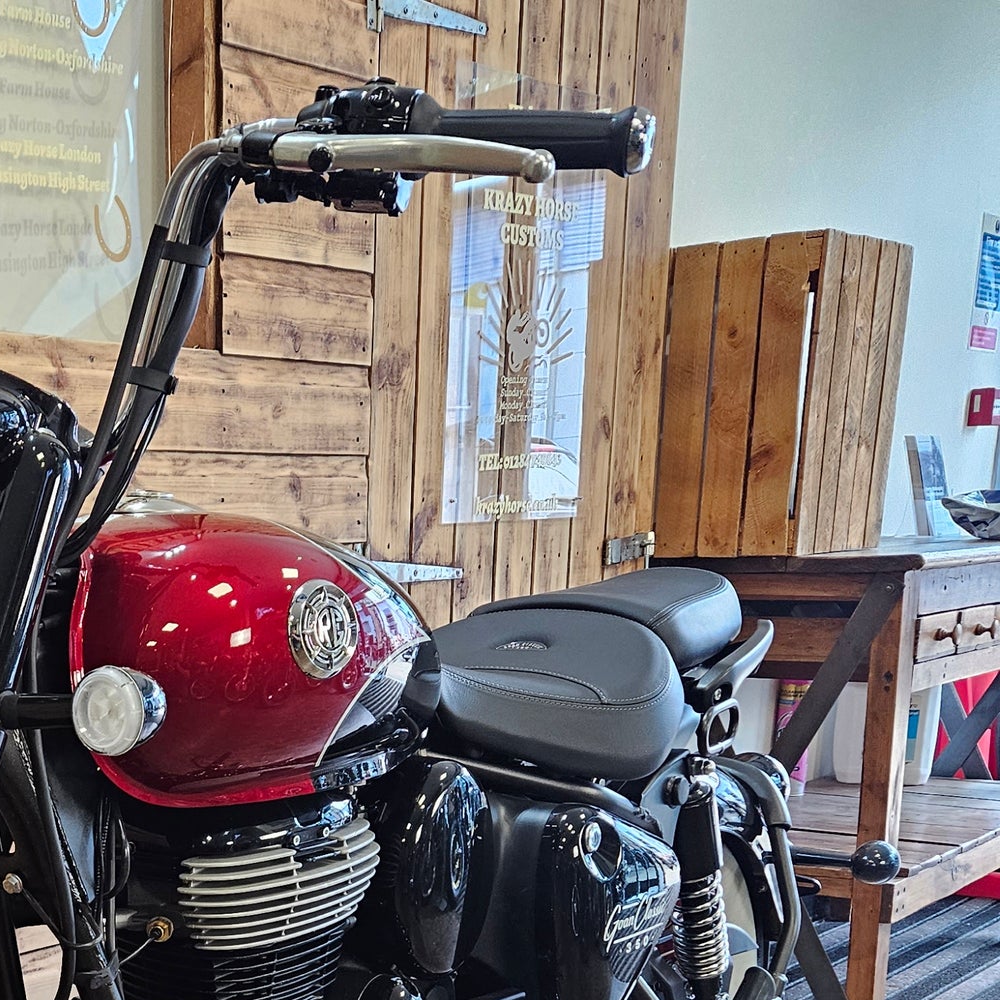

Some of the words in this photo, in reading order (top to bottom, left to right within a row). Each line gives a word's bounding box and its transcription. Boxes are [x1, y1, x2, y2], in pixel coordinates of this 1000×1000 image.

[34, 7, 72, 29] House
[22, 139, 58, 160] Horse
[59, 143, 102, 165] London
[48, 170, 77, 194] High
[77, 173, 111, 193] Street
[483, 188, 534, 216] KRAZY
[535, 197, 580, 222] HORSE
[500, 223, 564, 250] CUSTOMS
